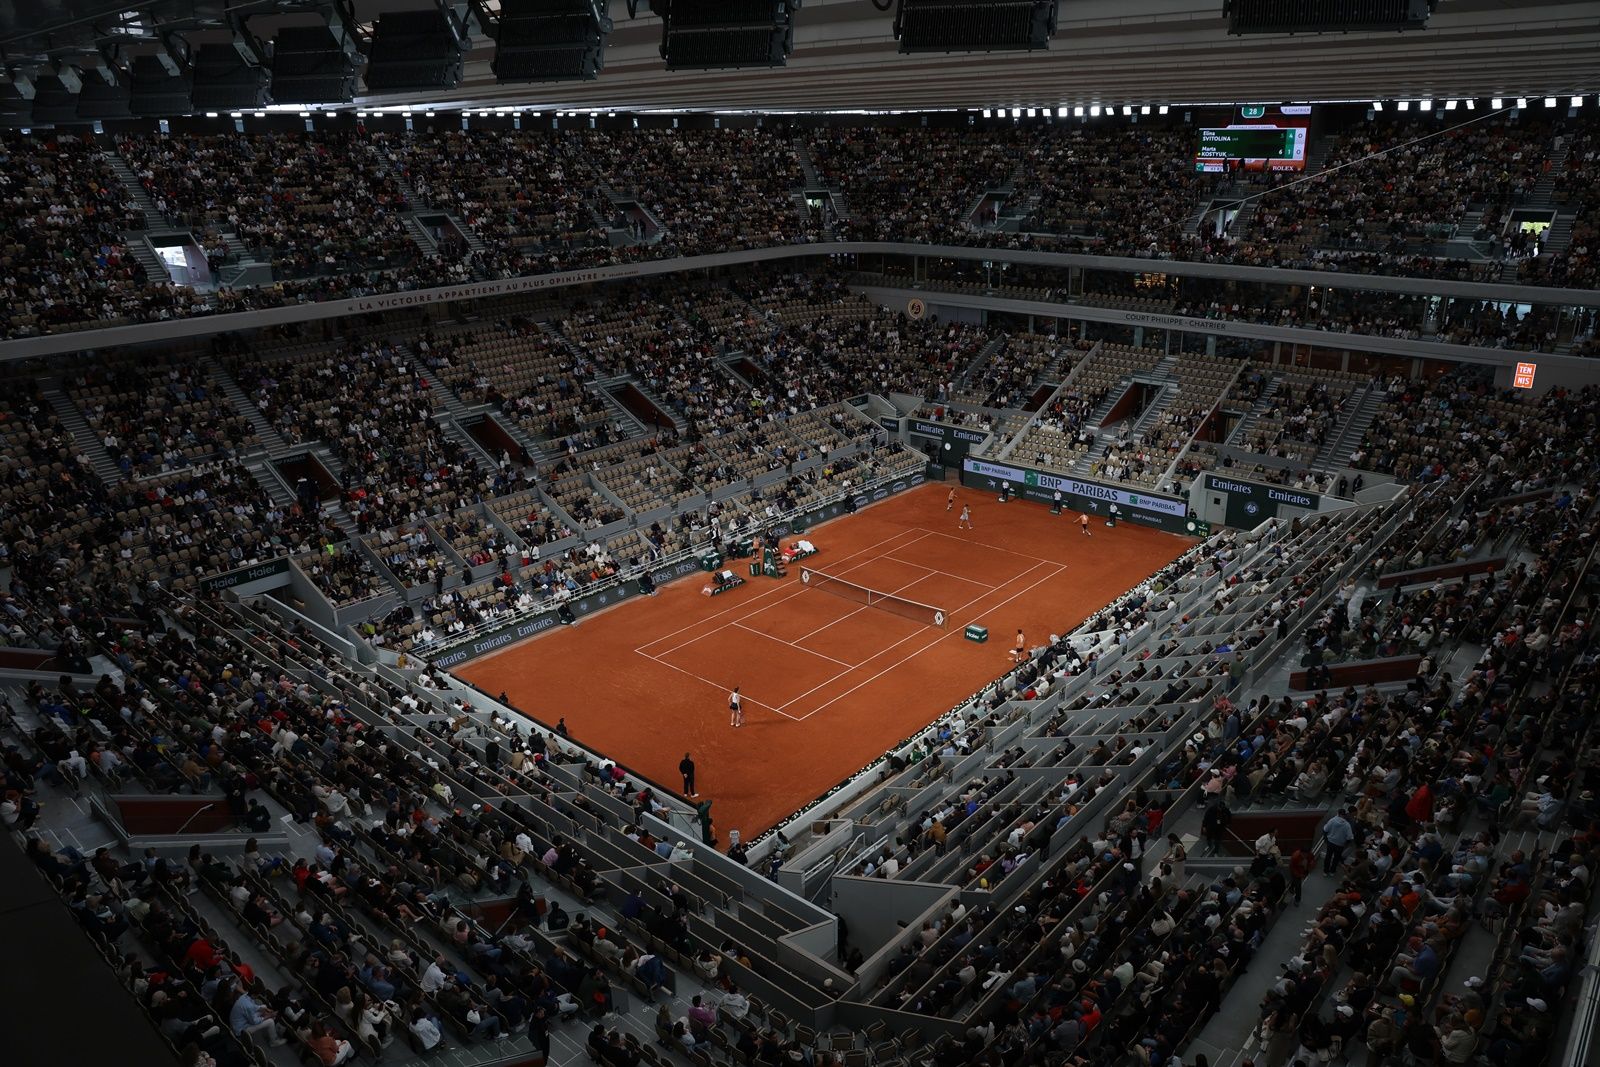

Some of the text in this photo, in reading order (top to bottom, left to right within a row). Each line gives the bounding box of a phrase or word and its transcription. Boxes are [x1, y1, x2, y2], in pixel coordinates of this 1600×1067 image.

[359, 301, 373, 311] LA
[378, 293, 432, 309] VICTOIRE
[438, 284, 502, 300] APPARTIENT
[505, 282, 519, 291] AU
[522, 279, 545, 290] PLUS
[1125, 312, 1150, 321] COURT
[1151, 316, 1183, 326] PHILIPPE
[1189, 319, 1226, 330] CHATRIER
[1519, 366, 1532, 374] TEN
[916, 422, 983, 442] Emirates Emirates
[981, 465, 1012, 477] BNP PARIBAS
[1040, 475, 1118, 501] BNP PARIBAS
[1212, 478, 1311, 506] Emirates Emirates
[1139, 498, 1176, 511] BNP PARIBAS
[209, 565, 276, 590] Haier Haier
[434, 616, 554, 668] mirates Emirates Emirates
